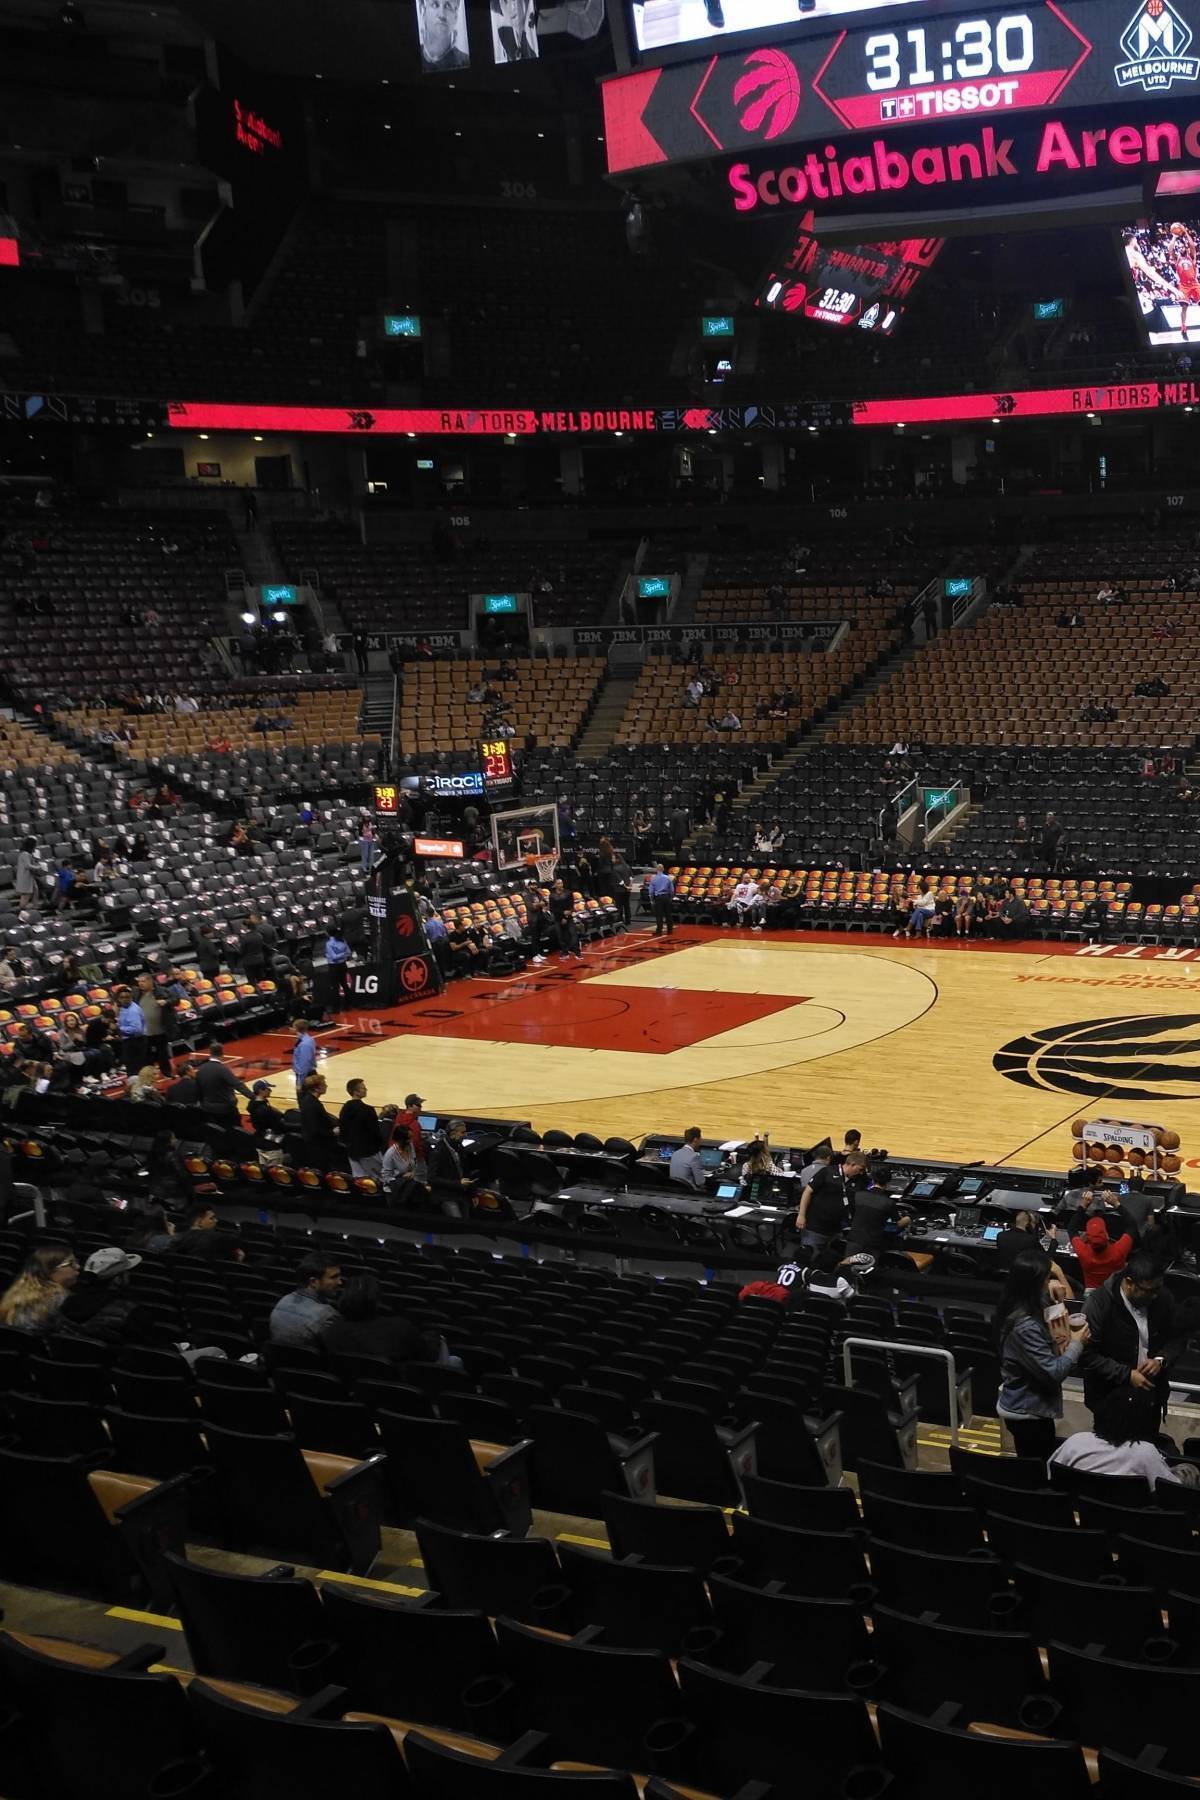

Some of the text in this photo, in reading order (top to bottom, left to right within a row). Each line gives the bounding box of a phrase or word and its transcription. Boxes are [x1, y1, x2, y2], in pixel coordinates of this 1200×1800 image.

[865, 13, 1034, 91] 31:30
[1121, 62, 1194, 78] MELBOURNE
[1146, 75, 1168, 85] UTD.
[916, 81, 1019, 115] TISSOT
[728, 127, 1018, 213] Scotiabank
[819, 287, 856, 313] 31:30
[540, 409, 656, 432] MELBOURNE
[1166, 495, 1184, 506] 107
[829, 507, 848, 518] 106
[449, 516, 471, 527] 105
[577, 631, 602, 643] IBM
[613, 631, 637, 642] IBM
[647, 629, 671, 641] IBM
[682, 628, 706, 640] IBM
[749, 627, 771, 638] IBM
[781, 627, 803, 638] IBM
[429, 635, 455, 648] IBM
[487, 756, 505, 775] 23
[380, 797, 393, 808] 23
[355, 974, 379, 994] LG
[1103, 1133, 1134, 1145] SPALDING
[777, 1268, 796, 1287] 10
